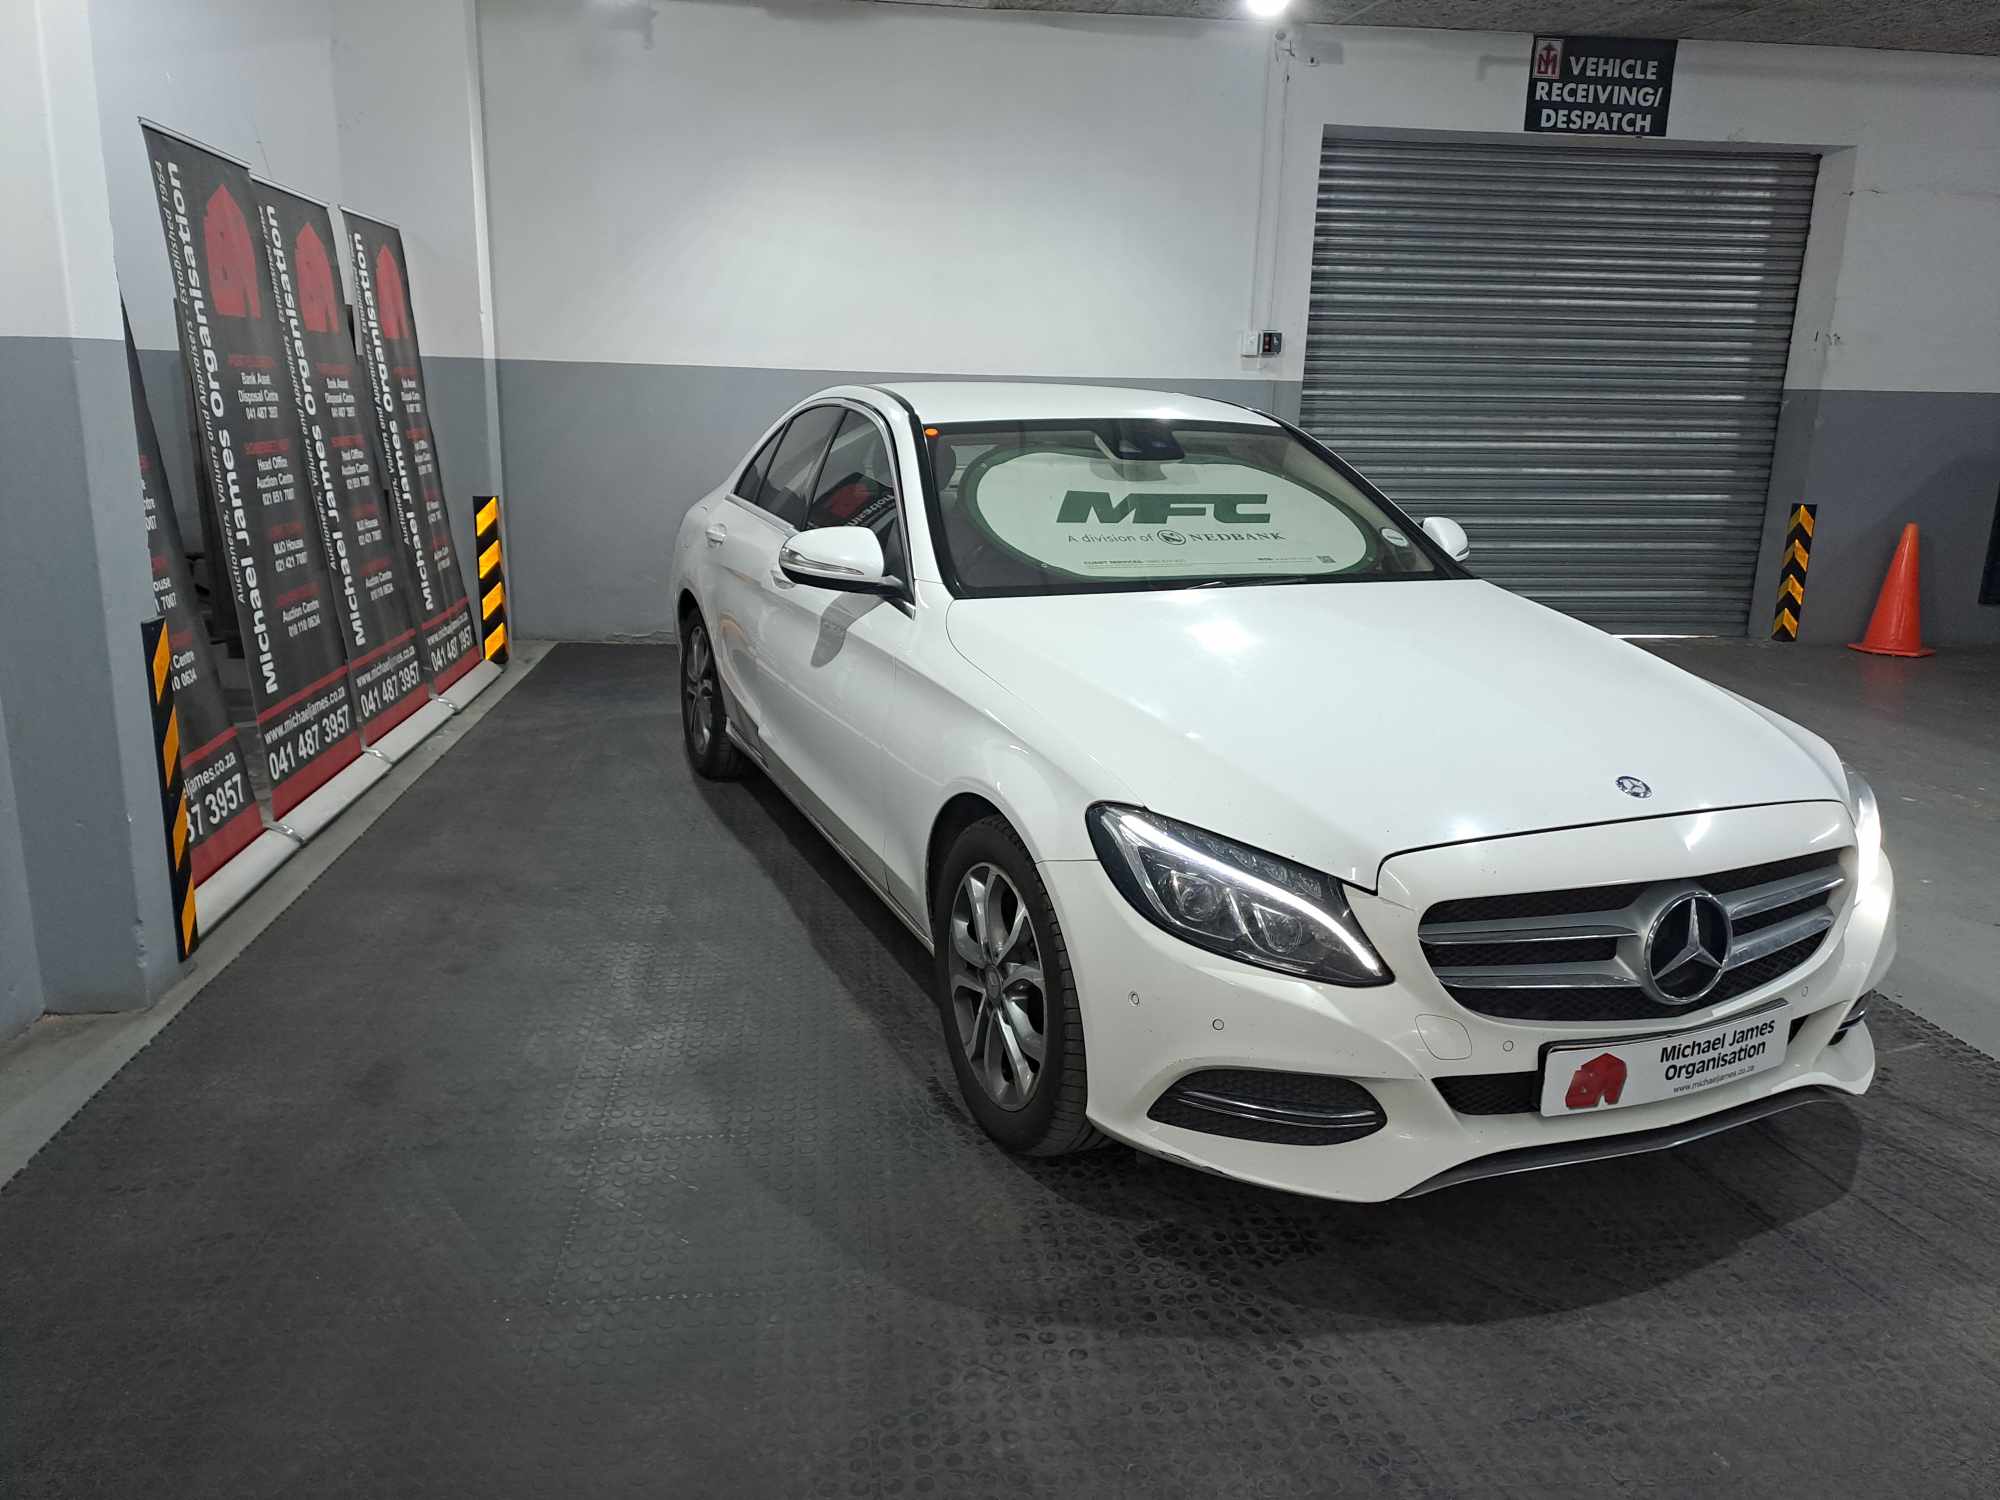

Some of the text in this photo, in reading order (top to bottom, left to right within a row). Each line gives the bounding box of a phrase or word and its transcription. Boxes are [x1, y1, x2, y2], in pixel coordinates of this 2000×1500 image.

[1535, 81, 1663, 107] RECEIVING/
[1569, 56, 1658, 80] VEHICLE
[1540, 109, 1652, 133] DESPATCH
[155, 160, 169, 202] 1964
[163, 207, 188, 304] Established
[266, 205, 316, 415] Organisation
[354, 232, 393, 412] Organisation
[187, 321, 208, 406] Appraisers
[168, 162, 278, 694] Michael James Organisation
[201, 408, 214, 441] and
[211, 445, 225, 503] Valuers
[312, 425, 339, 522] James
[389, 420, 412, 504] James
[1056, 490, 1270, 524] MFC
[406, 511, 433, 610] Michael
[1082, 533, 1136, 543] division
[1140, 533, 1155, 542] of
[1188, 532, 1287, 542] NEDBANK
[332, 531, 366, 646] Michael
[431, 646, 447, 672] 041
[264, 686, 345, 744] www.michaeljames.co.za
[361, 660, 420, 718] 041 487 3957
[269, 704, 350, 780] 041 487 3957
[183, 752, 237, 800] ljames.co.za
[205, 773, 244, 824] 3957
[1660, 1020, 1775, 1063] Michael James
[1665, 1041, 1766, 1081] Organisation
